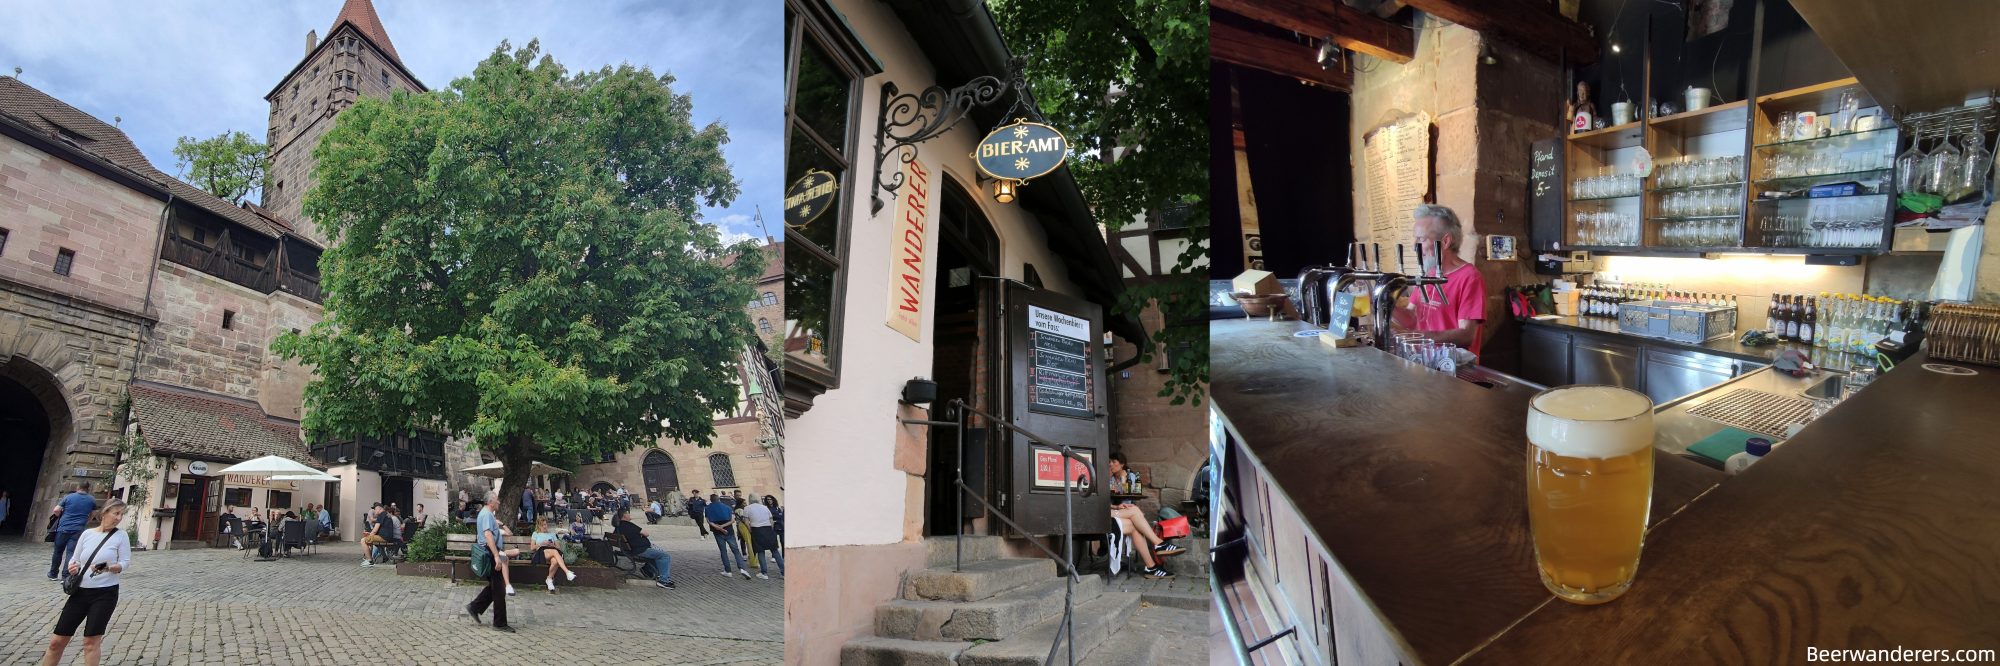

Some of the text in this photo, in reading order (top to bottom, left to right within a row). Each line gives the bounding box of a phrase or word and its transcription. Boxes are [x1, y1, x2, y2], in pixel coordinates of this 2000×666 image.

[982, 136, 1062, 158] BIER-AMT
[1534, 146, 1554, 167] Pfand
[899, 160, 928, 314] WANDERER
[1035, 309, 1053, 322] Unsere
[1035, 320, 1047, 329] vom
